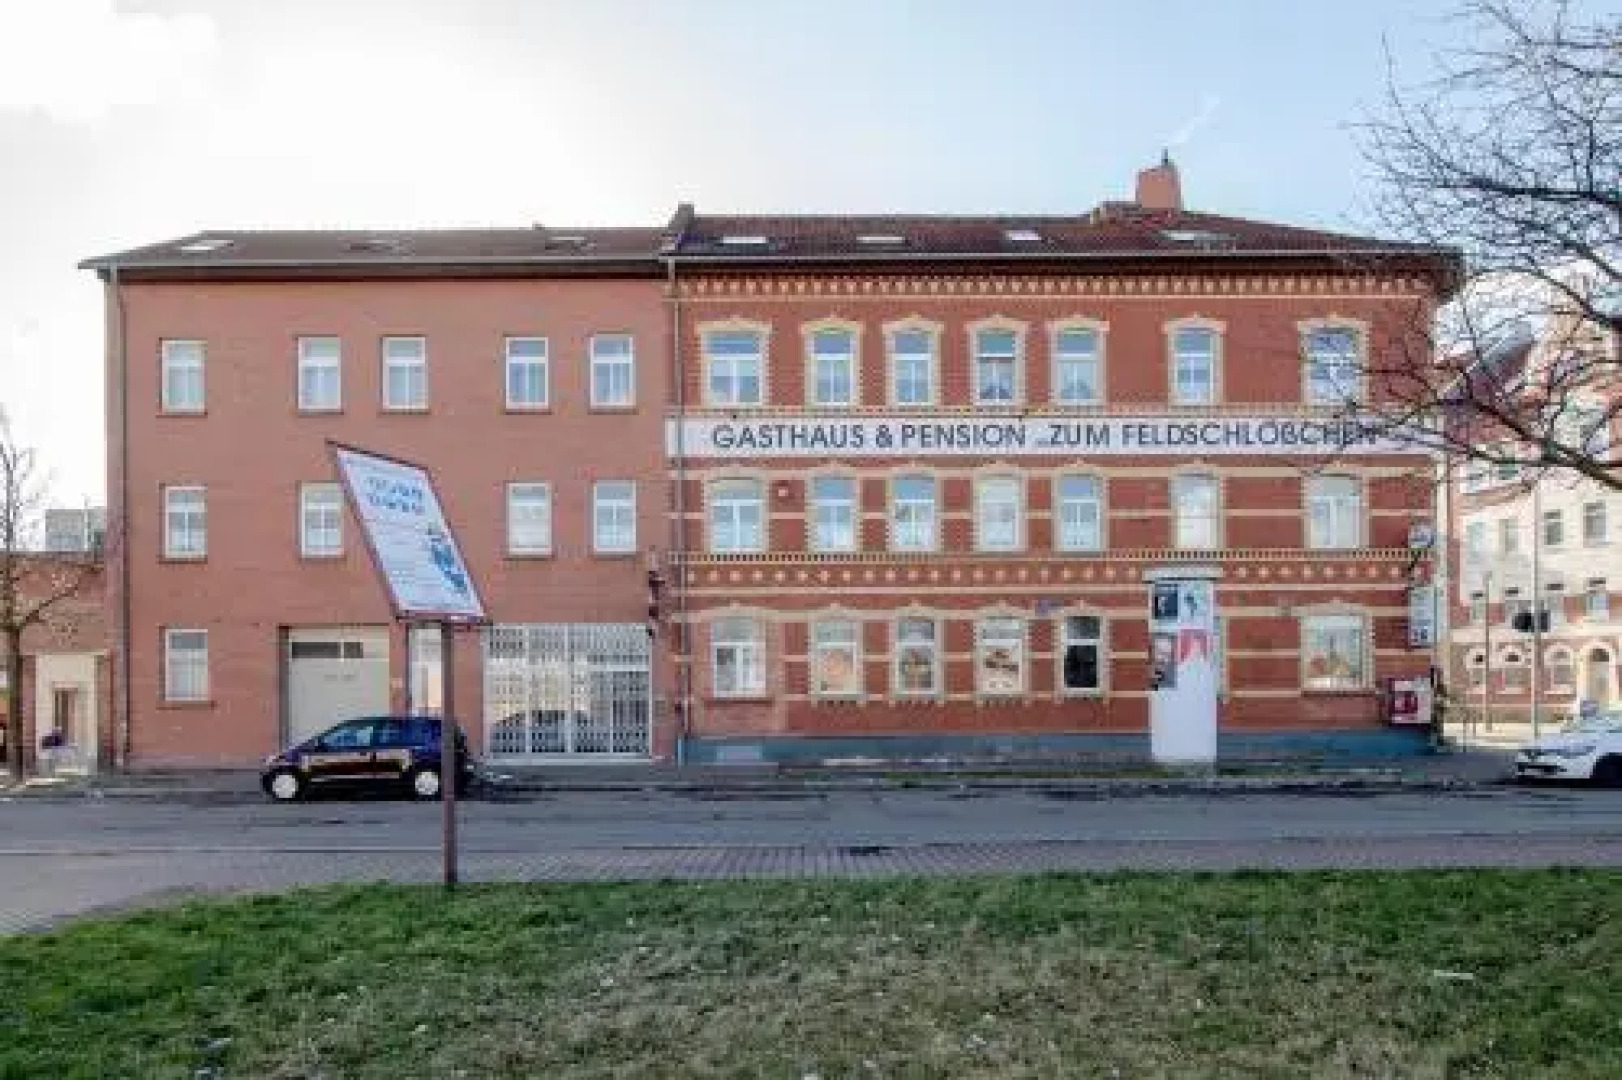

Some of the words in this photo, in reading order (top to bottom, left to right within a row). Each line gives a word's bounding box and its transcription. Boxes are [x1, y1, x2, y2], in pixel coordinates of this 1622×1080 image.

[713, 424, 864, 448] GASTHAUS
[875, 424, 894, 448] &
[901, 423, 1027, 448] PENSION
